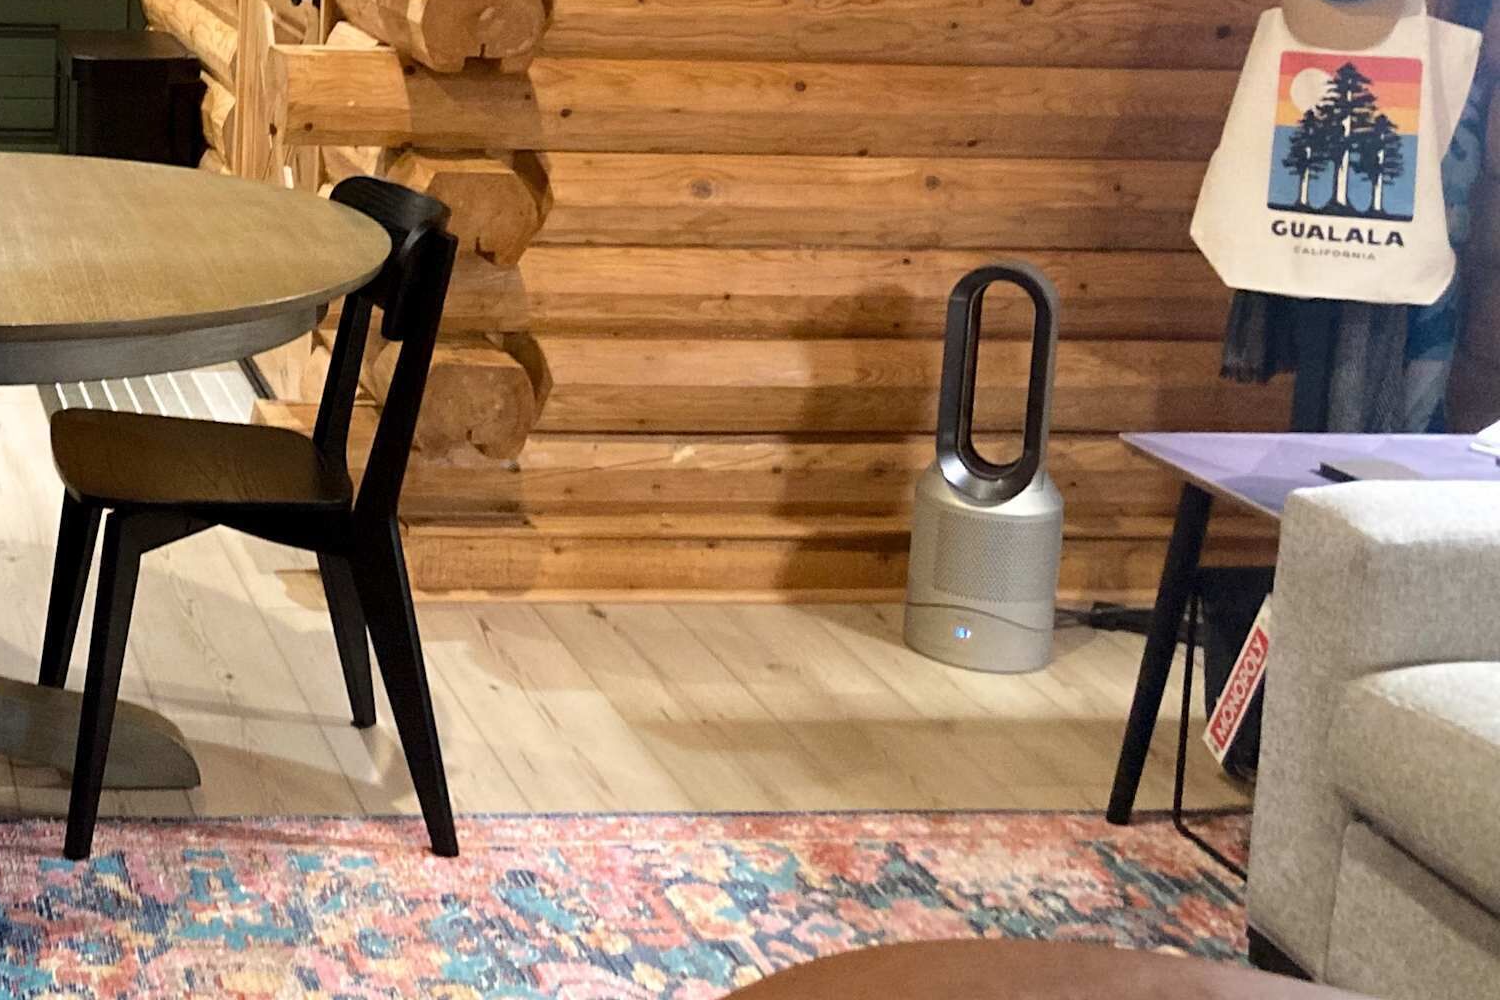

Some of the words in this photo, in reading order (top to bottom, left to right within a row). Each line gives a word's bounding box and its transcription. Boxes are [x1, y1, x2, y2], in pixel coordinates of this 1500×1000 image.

[1271, 220, 1405, 247] GUALALA
[1293, 246, 1376, 261] CALIFORNIA
[1214, 634, 1264, 743] MONOPOLY
